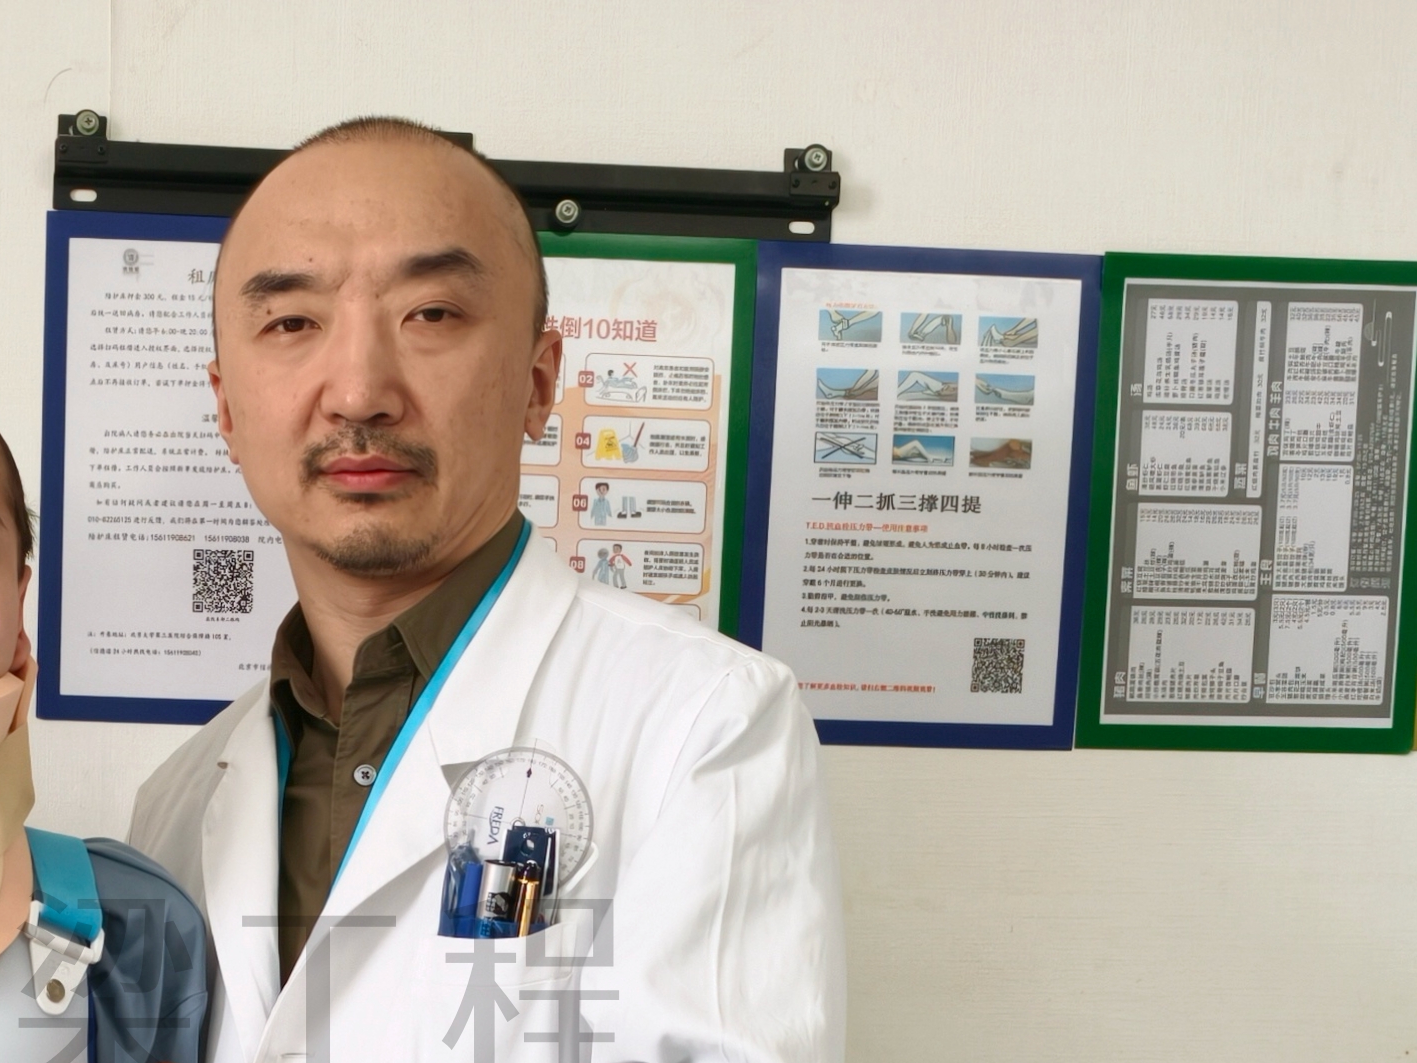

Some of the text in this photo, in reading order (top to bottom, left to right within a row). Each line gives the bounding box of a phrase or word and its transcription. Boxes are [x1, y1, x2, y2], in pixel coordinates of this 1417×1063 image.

[579, 374, 593, 384] 02
[1269, 381, 1283, 404] 羊肉
[1268, 407, 1281, 431] 牛肉
[576, 436, 590, 446] 04
[573, 498, 588, 508] 06
[811, 490, 982, 513] 一伸二抓三撑四提
[570, 559, 584, 569] 08
[487, 805, 504, 845] FREDA
